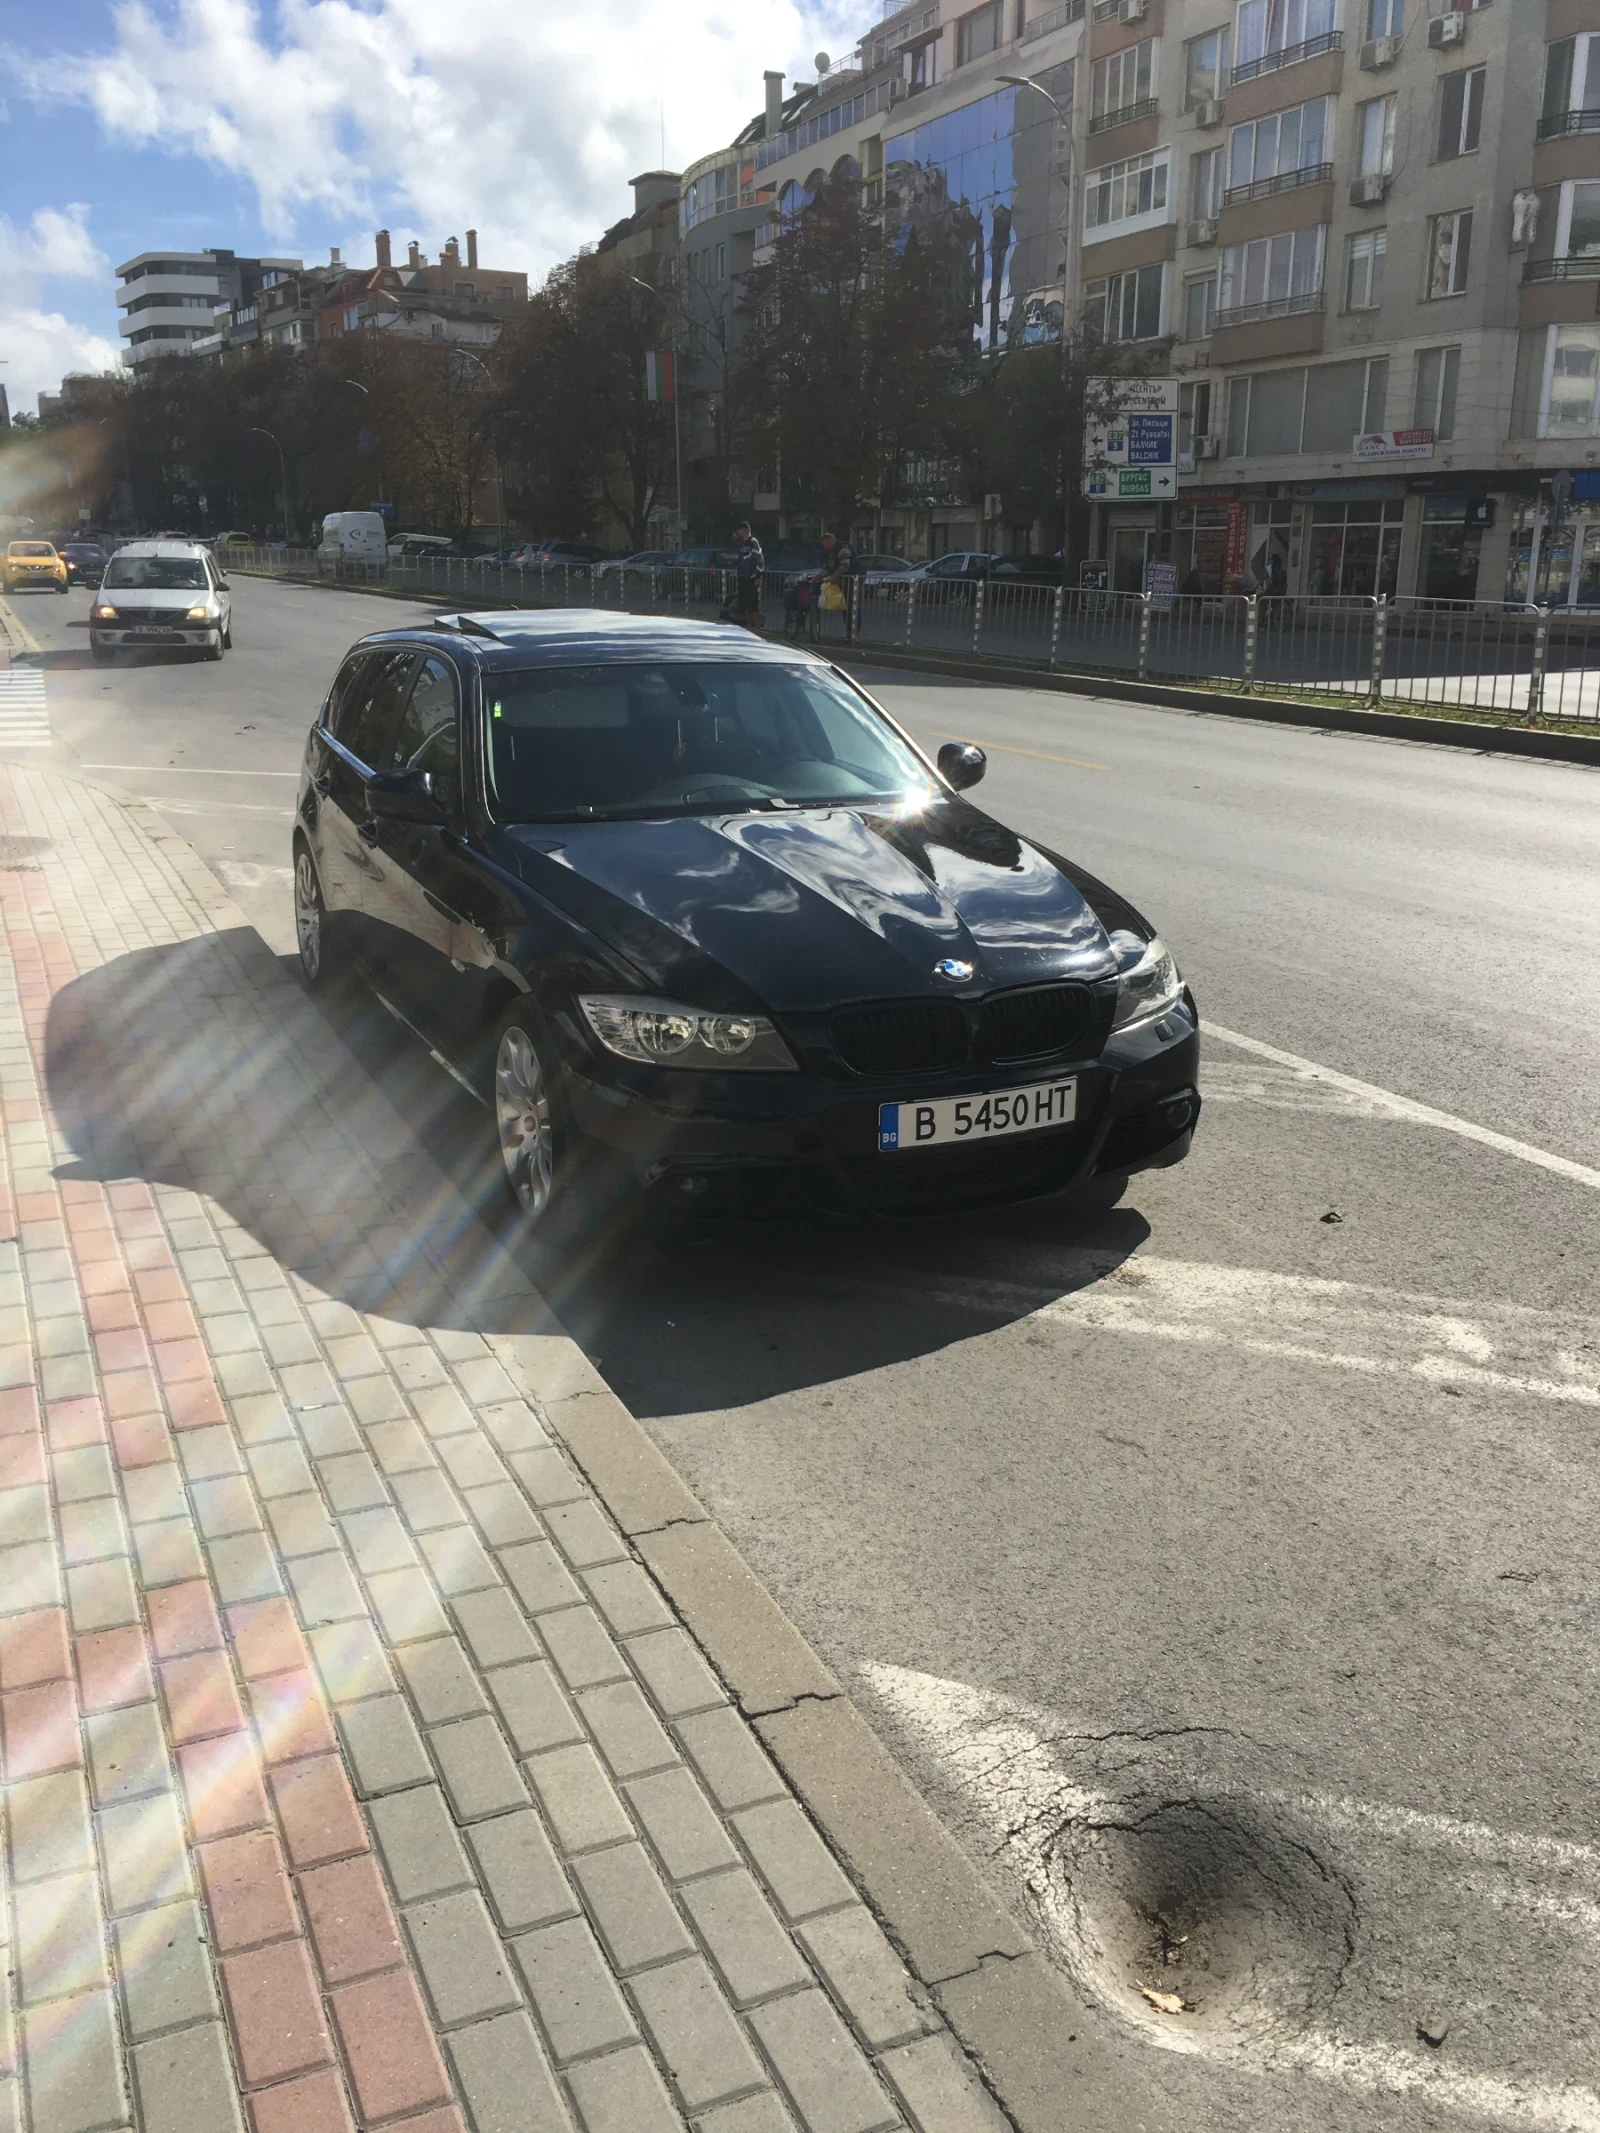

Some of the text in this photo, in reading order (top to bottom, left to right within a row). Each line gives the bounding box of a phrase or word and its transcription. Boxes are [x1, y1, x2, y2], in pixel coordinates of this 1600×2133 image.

[1133, 384, 1162, 394] ЦЕНТЪР
[1143, 418, 1168, 428] Пясъци
[1108, 432, 1123, 440] E87
[1141, 430, 1170, 439] Pyasatsi
[1112, 442, 1119, 450] 9
[1130, 441, 1158, 449] БАЛЧИК
[1130, 451, 1160, 460] BALCHIK
[1121, 473, 1148, 482] БУРГАС
[1121, 484, 1149, 493] BURGAS
[915, 1107, 936, 1141] B
[882, 1132, 897, 1143] BG
